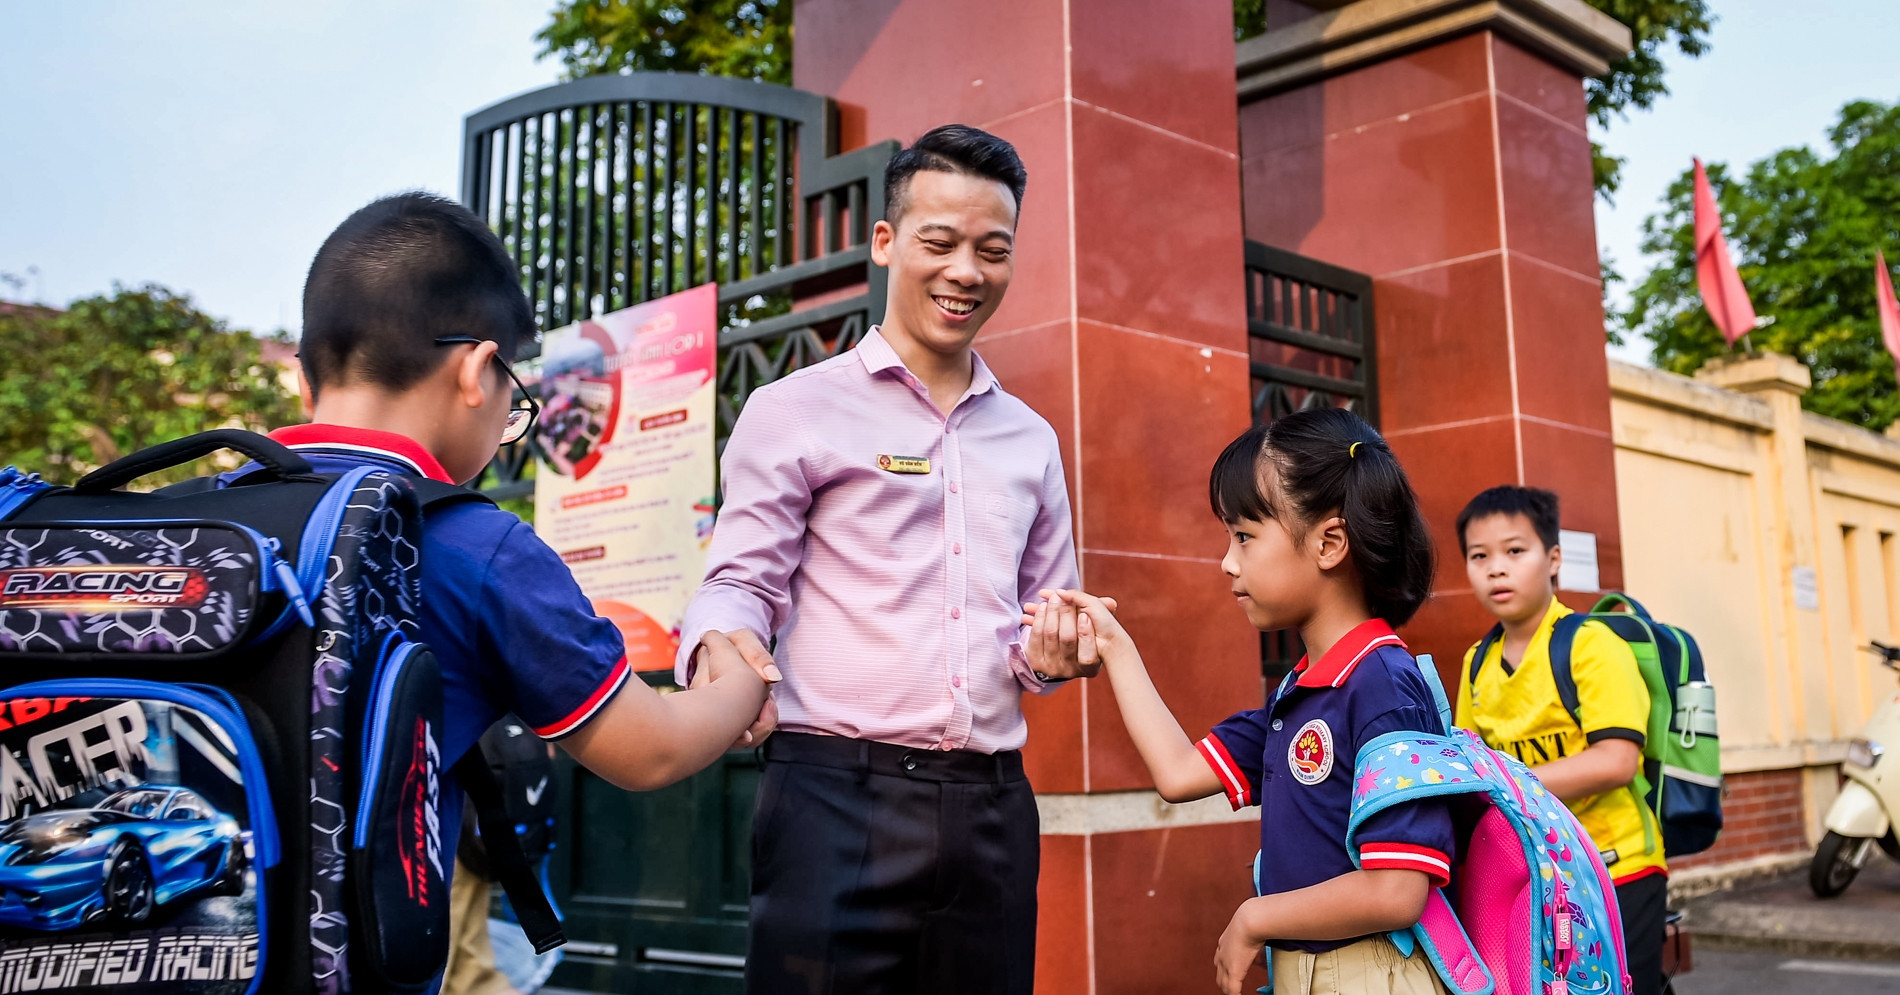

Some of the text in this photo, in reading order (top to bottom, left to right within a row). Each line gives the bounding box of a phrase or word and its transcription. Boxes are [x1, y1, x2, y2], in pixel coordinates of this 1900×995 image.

[3, 571, 188, 594] RACING
[109, 593, 183, 603] SPORT
[425, 720, 445, 882] FAST
[0, 933, 260, 994] MODIFIED RACING
